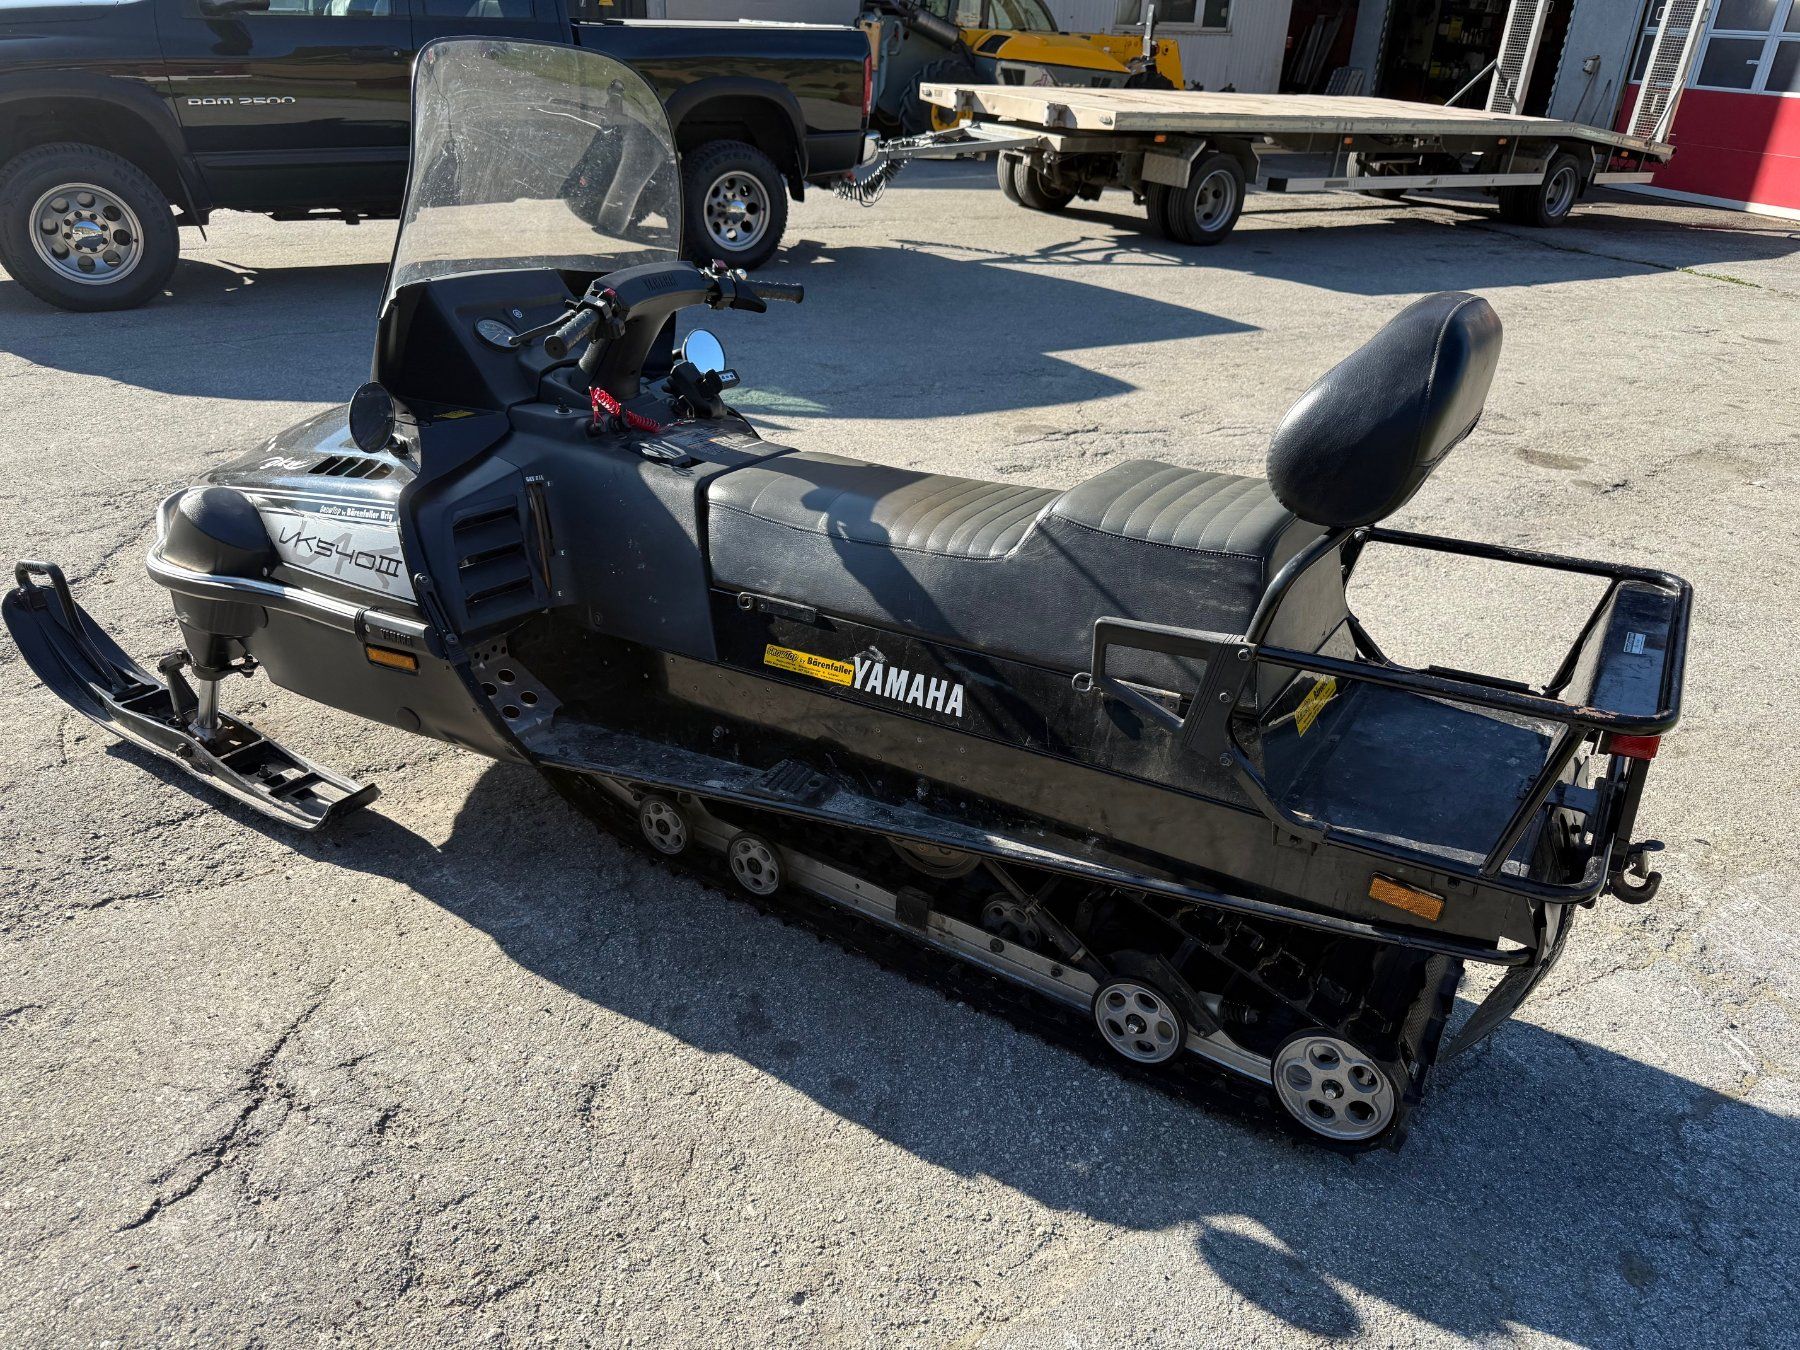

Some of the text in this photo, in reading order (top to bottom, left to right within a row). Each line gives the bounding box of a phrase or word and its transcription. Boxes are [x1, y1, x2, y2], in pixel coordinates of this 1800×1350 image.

[239, 96, 296, 106] 2500
[806, 656, 852, 675] Bärenfaller
[853, 656, 965, 718] YAMAHA
